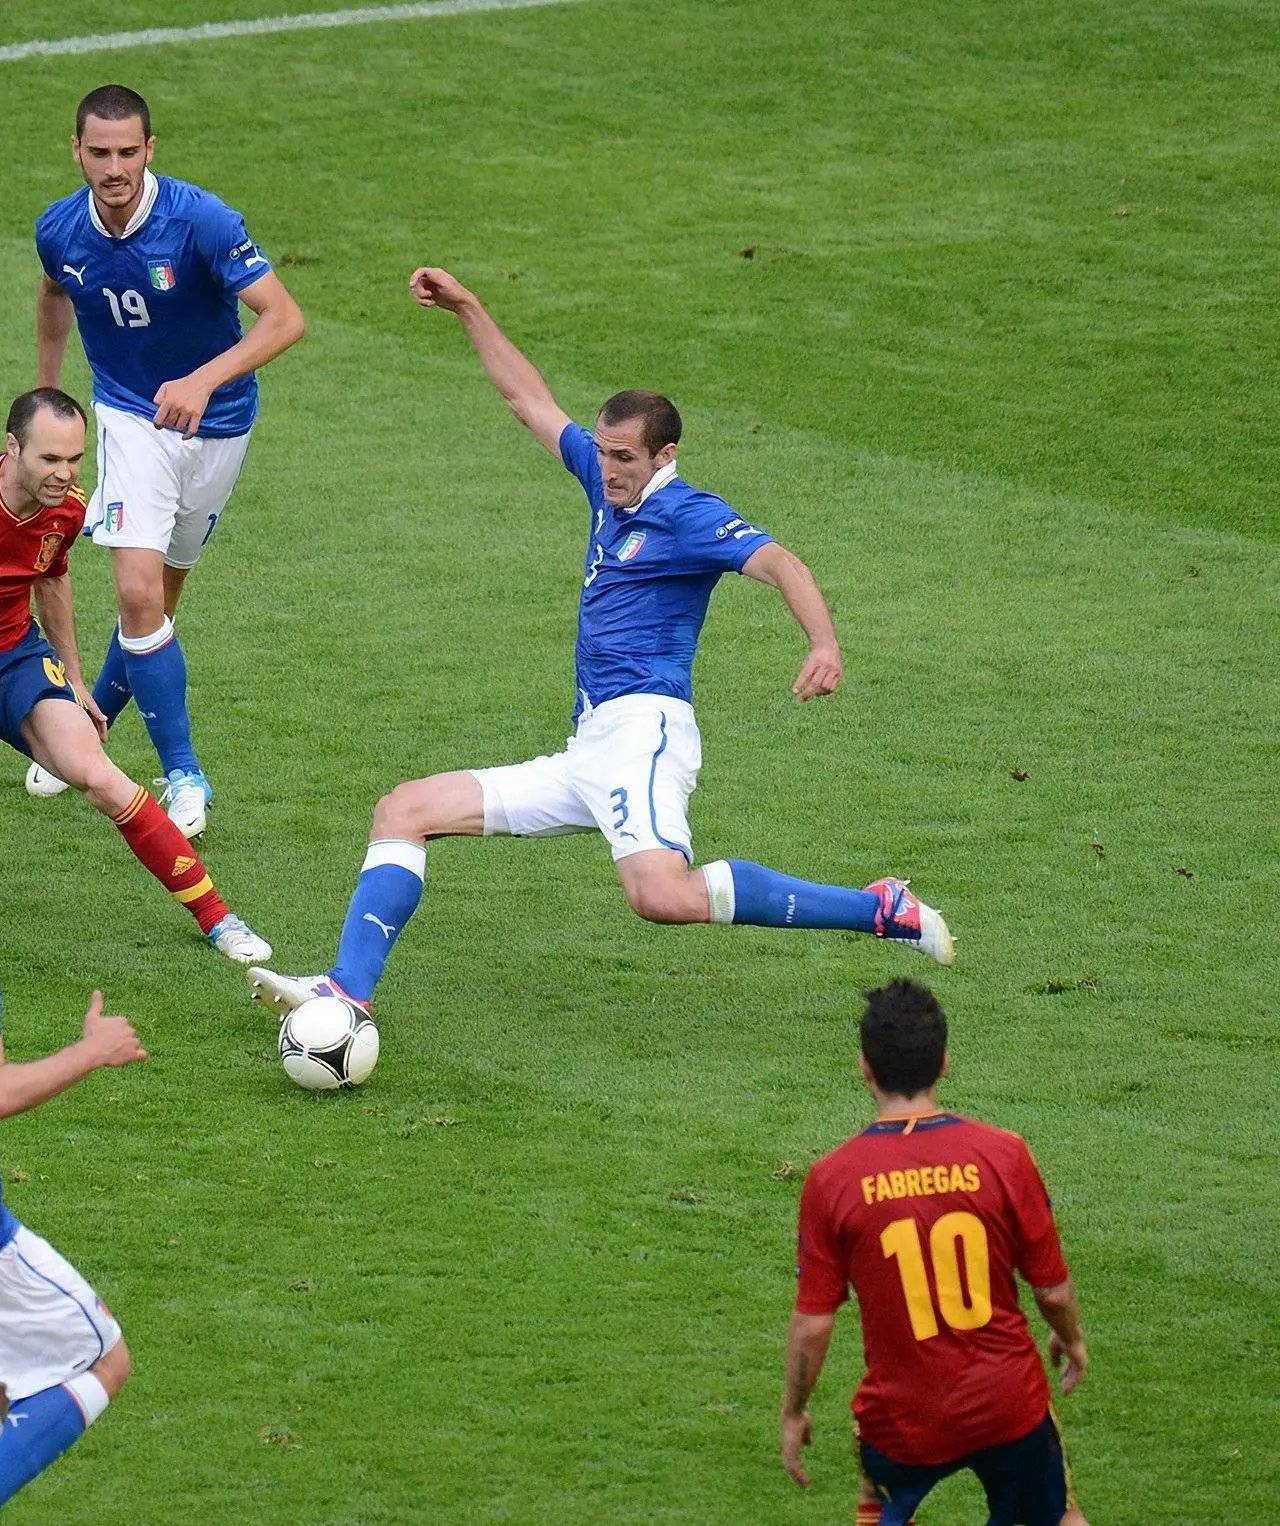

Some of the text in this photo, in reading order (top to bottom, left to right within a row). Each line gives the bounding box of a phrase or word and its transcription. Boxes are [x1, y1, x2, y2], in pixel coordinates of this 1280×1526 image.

[103, 287, 151, 328] 19
[583, 544, 604, 588] 3
[610, 787, 628, 830] 3
[785, 894, 796, 923] ITALIA
[861, 1163, 981, 1205] FABREGAS
[880, 1211, 993, 1341] 10
